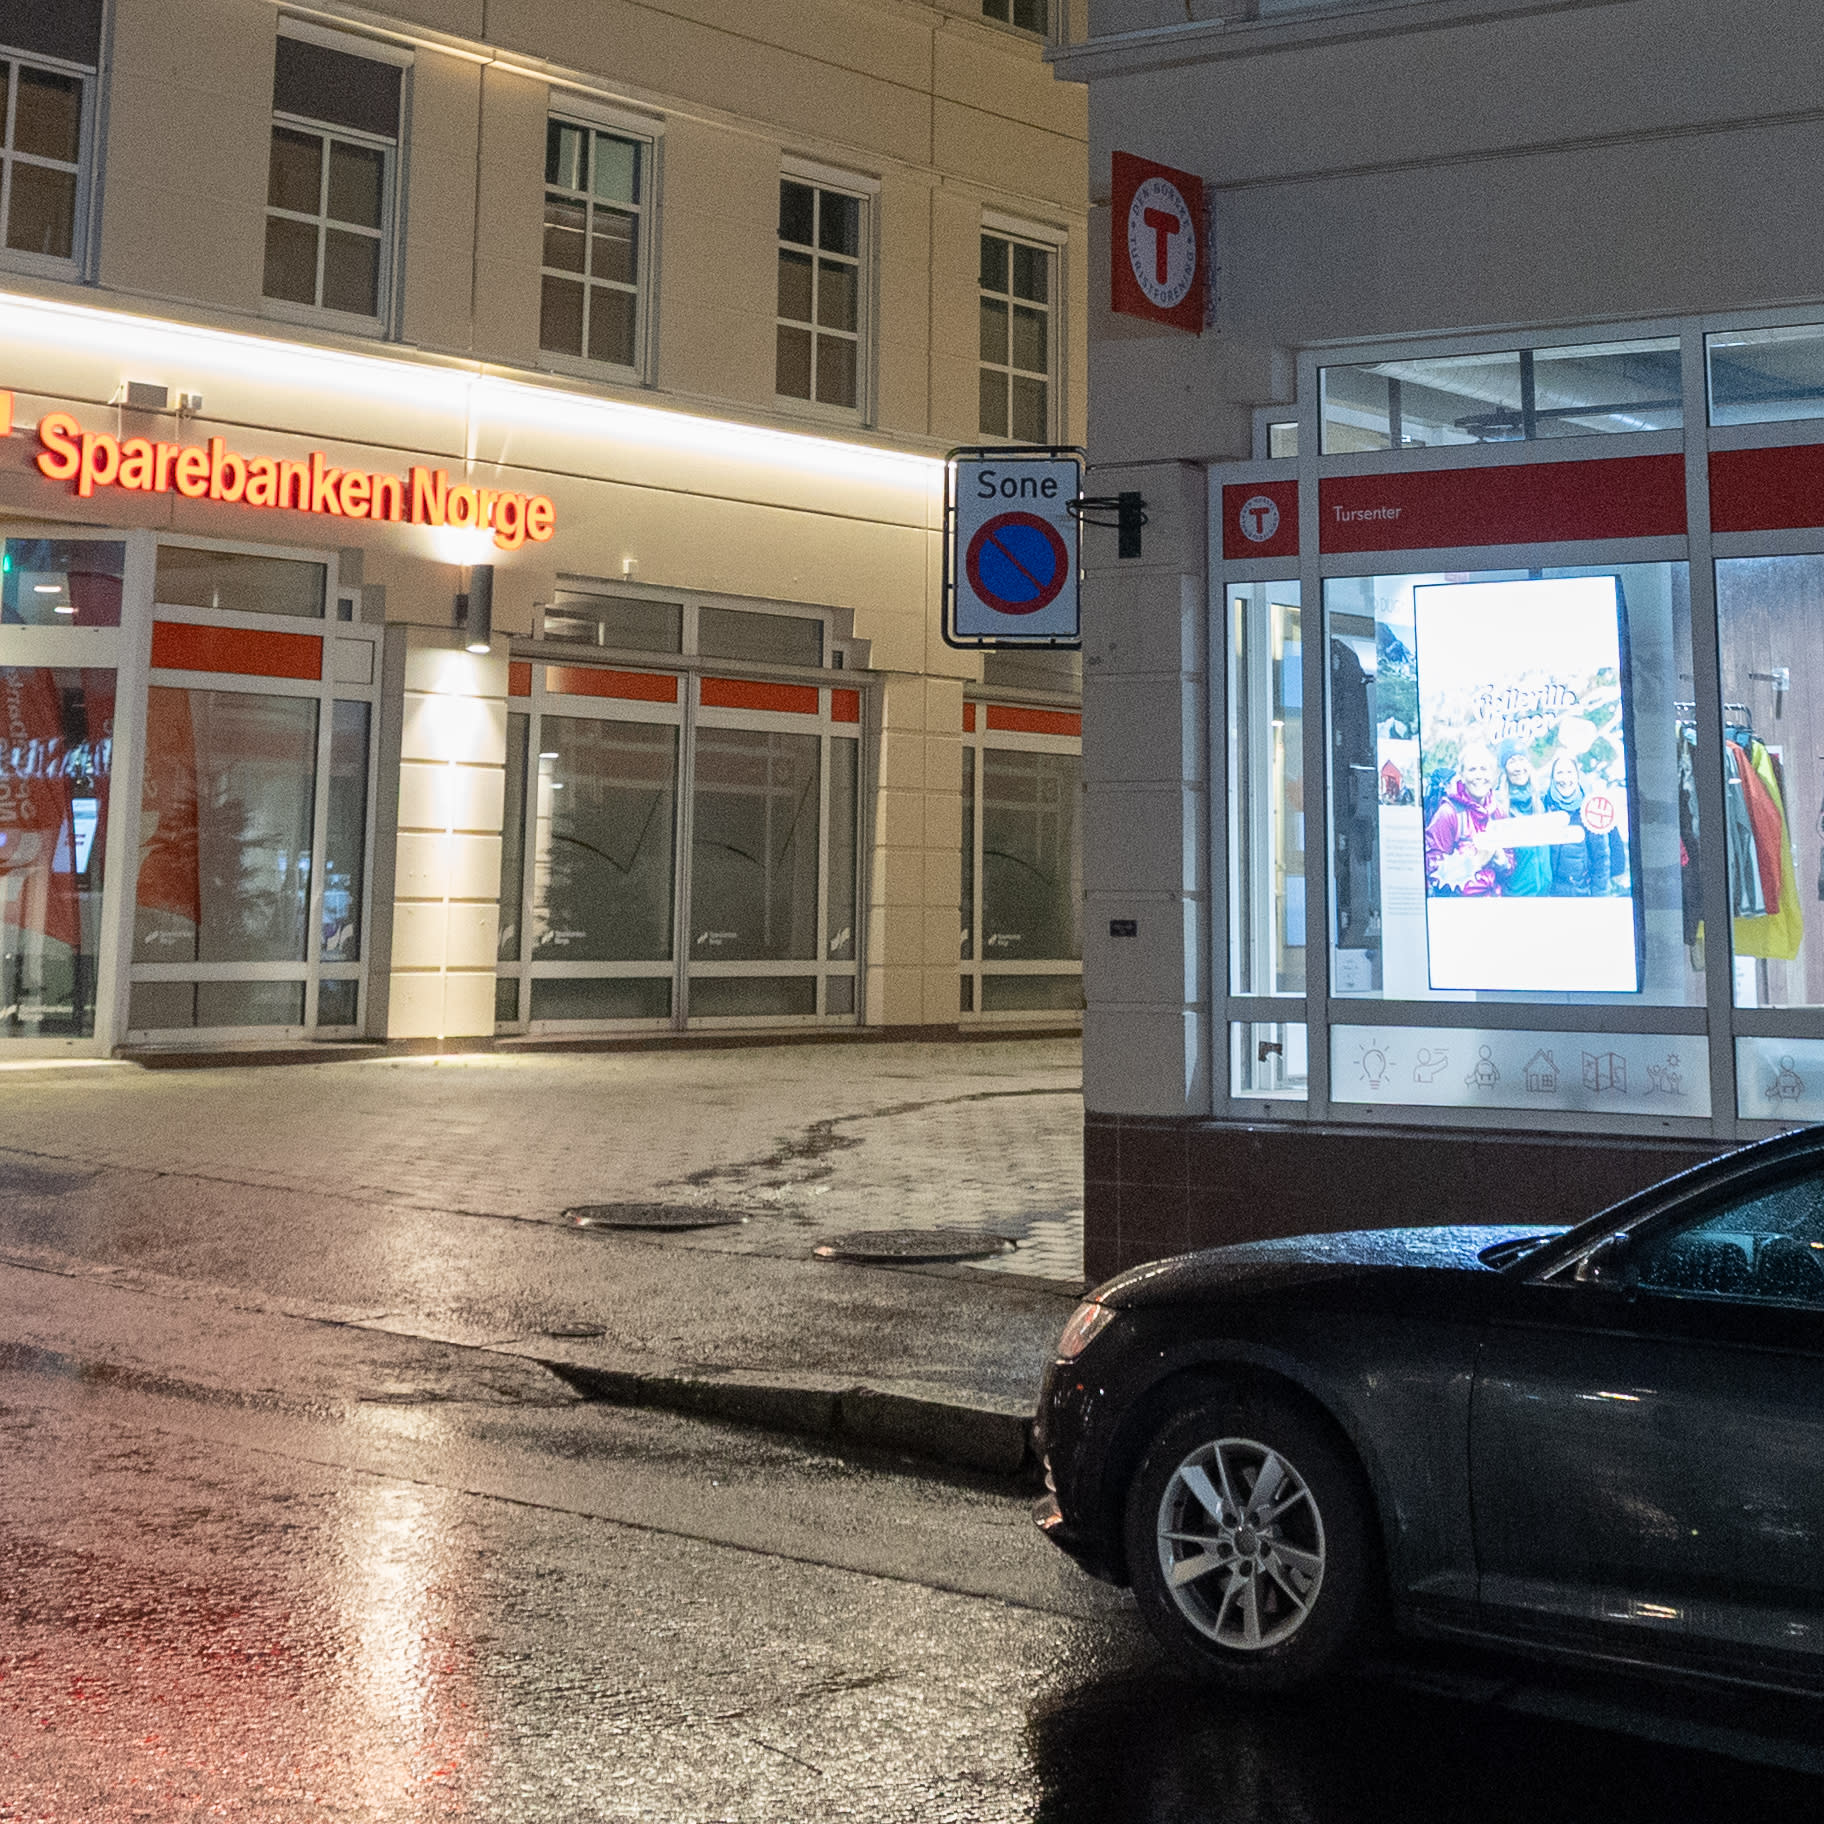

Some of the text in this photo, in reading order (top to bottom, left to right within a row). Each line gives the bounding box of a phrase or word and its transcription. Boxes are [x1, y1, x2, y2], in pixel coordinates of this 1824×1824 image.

[1143, 207, 1181, 286] T
[36, 412, 557, 551] Sparebanken Norge
[977, 469, 1059, 500] Sone
[1333, 503, 1403, 523] Tursenter
